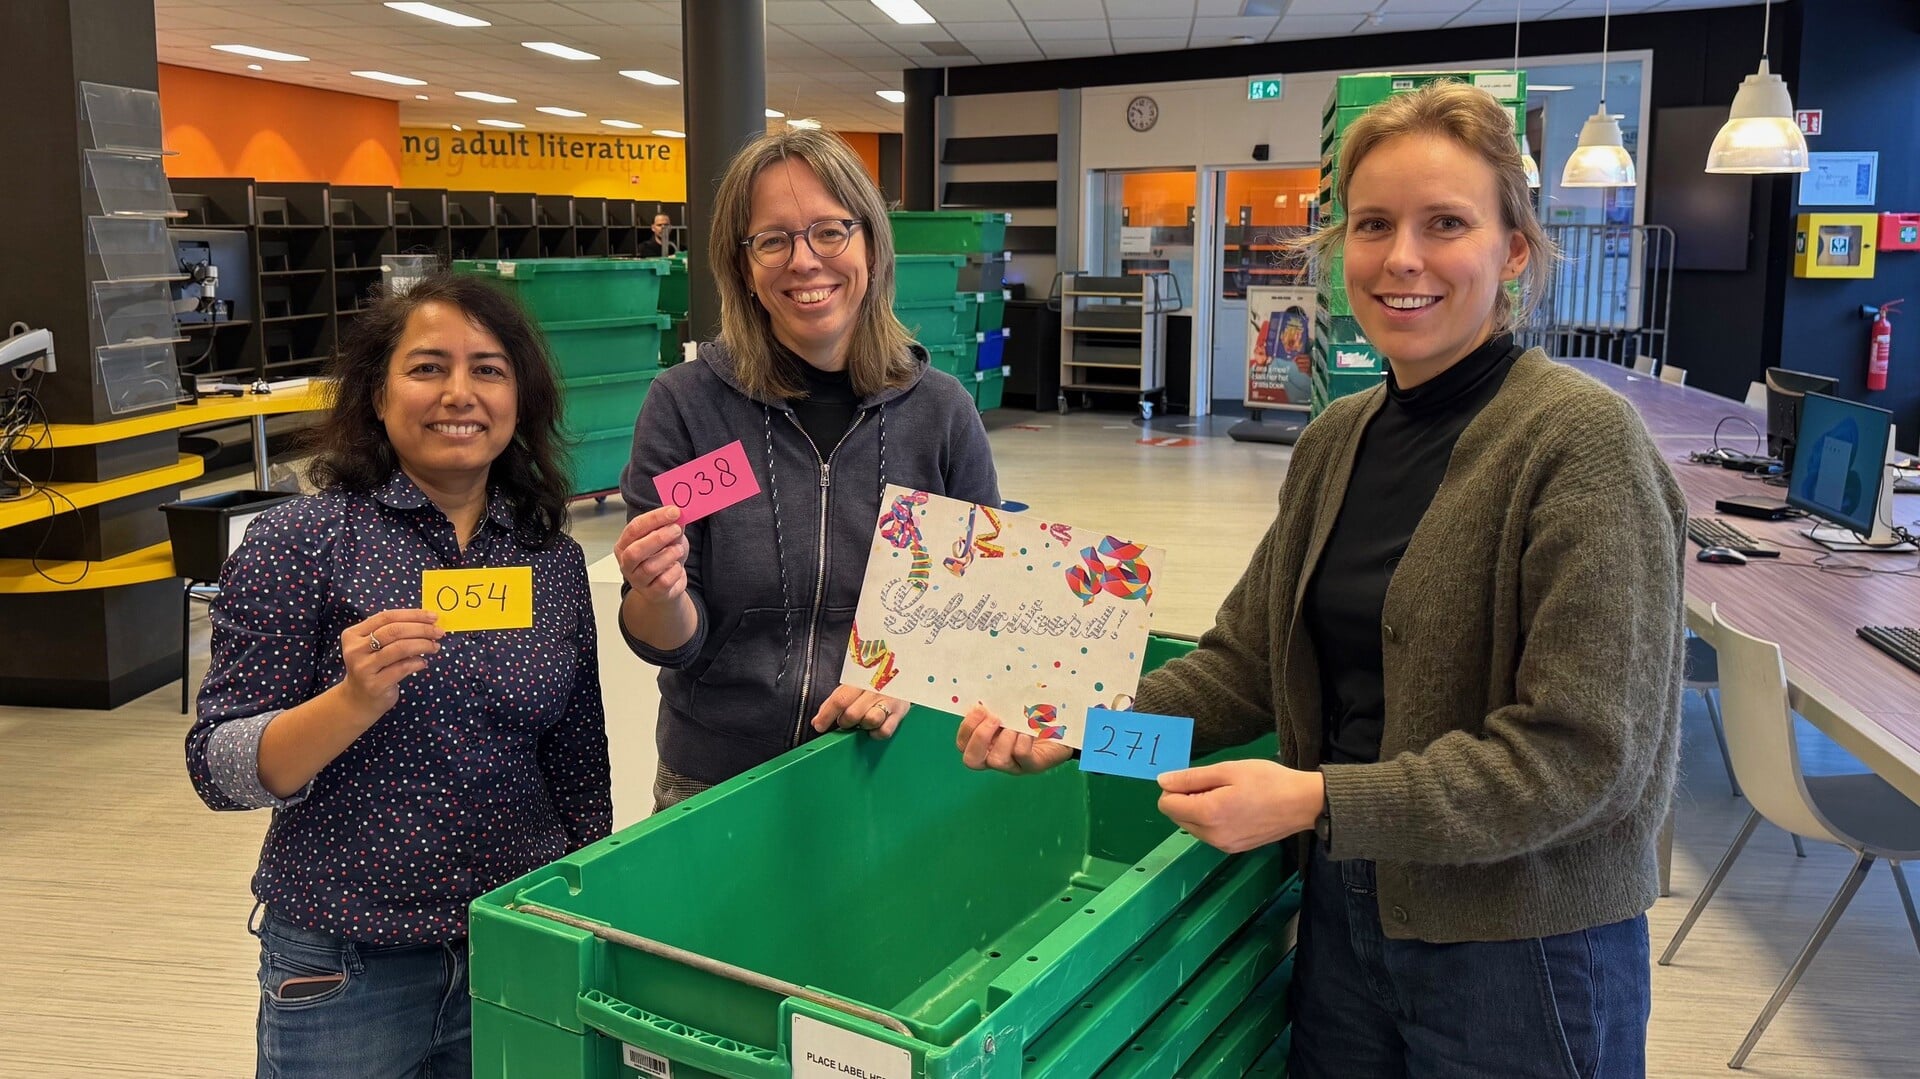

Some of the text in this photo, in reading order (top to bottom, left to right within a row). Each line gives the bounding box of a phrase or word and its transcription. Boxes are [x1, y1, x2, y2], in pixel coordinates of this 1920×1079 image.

[400, 131, 671, 162] ng adult literature
[671, 457, 737, 509] 038
[436, 582, 507, 612] 054
[1093, 725, 1161, 766] 271
[806, 1051, 836, 1070] PLACE
[838, 1062, 868, 1079] LABEL
